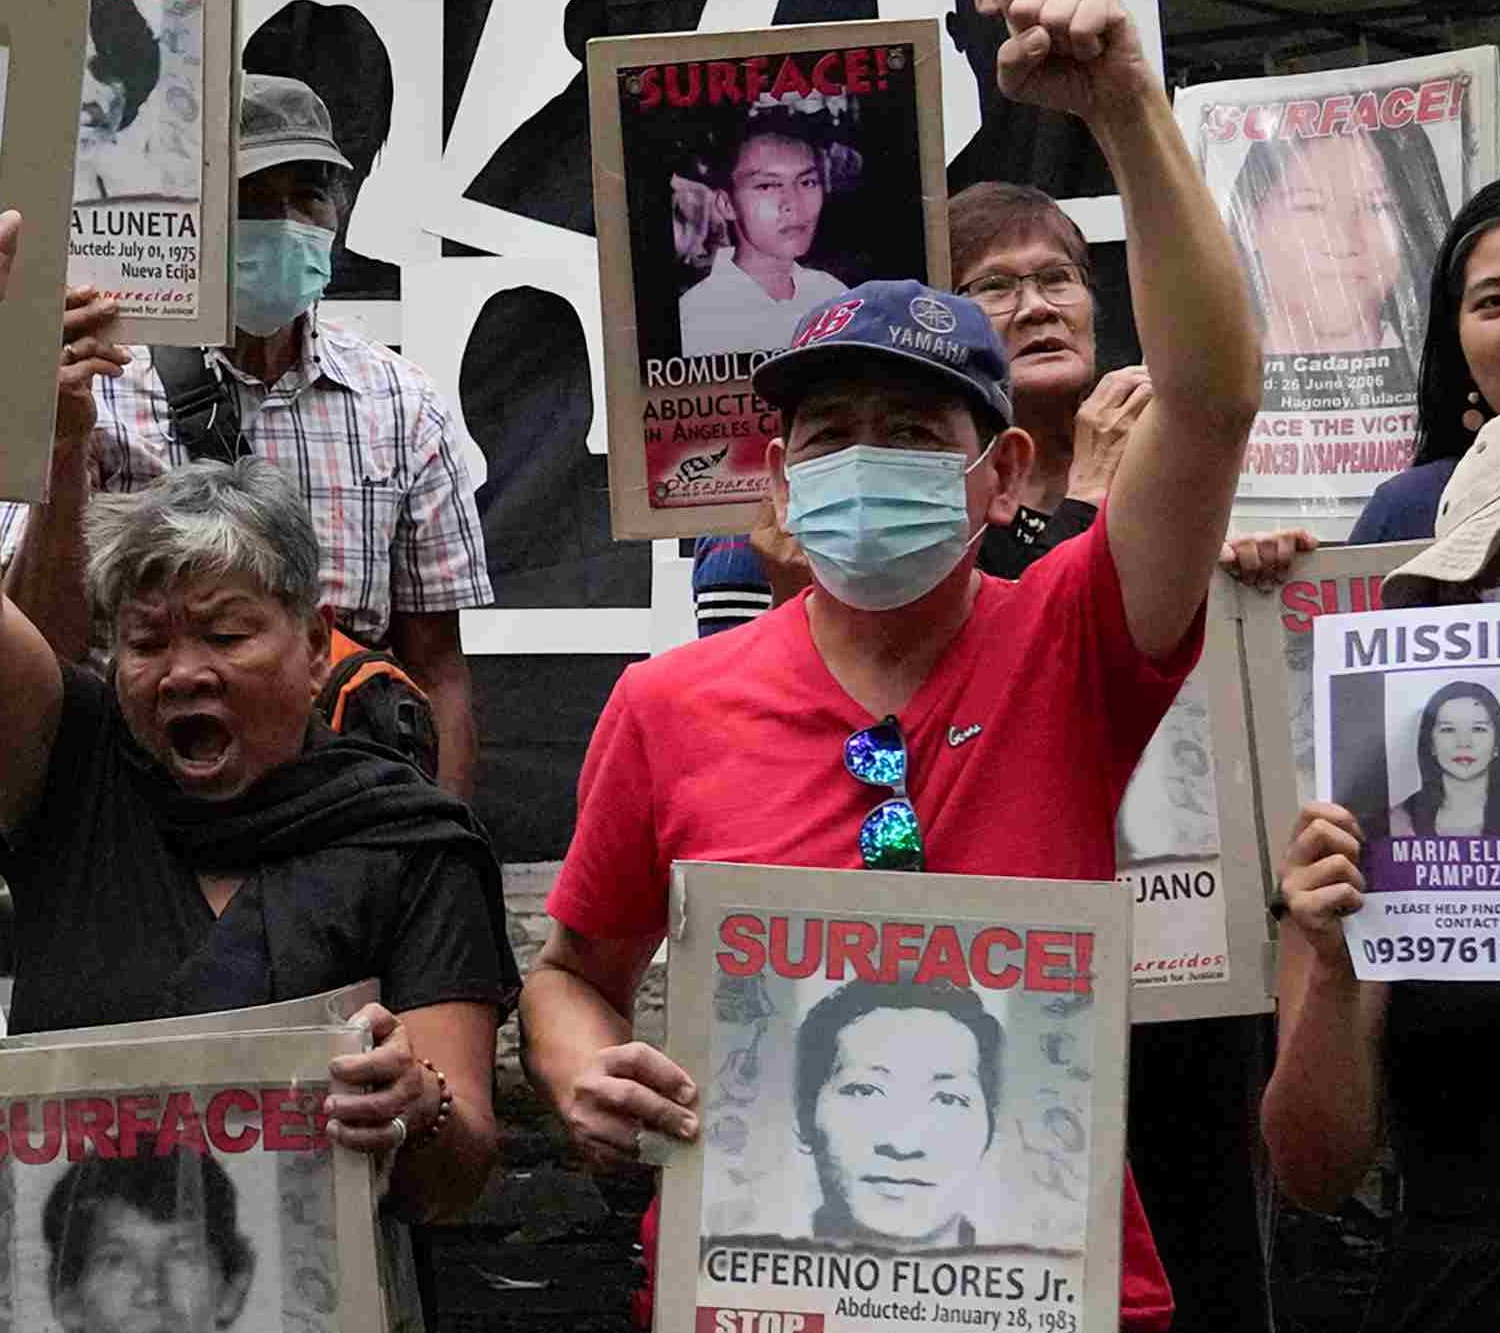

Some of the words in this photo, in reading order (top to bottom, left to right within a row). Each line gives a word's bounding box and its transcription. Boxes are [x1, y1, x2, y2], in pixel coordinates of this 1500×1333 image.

[641, 48, 889, 109] SURFACE!
[1206, 77, 1469, 141] SURFACE!
[93, 210, 197, 238] LUNETA
[118, 241, 144, 262] July
[148, 245, 165, 262] 01,
[169, 246, 196, 263] 1975
[121, 263, 163, 279] Nueva
[166, 264, 197, 283] Ecija
[888, 325, 969, 365] YAMAHA
[1293, 354, 1390, 375] Cadapan
[1310, 418, 1355, 437] THE
[1392, 840, 1461, 862] MARIA
[1385, 903, 1431, 916] PLEASE
[1434, 904, 1468, 916] HELP
[1434, 917, 1500, 929] CONTACT
[715, 913, 1096, 994] SURFACE!
[706, 1247, 880, 1292] CEFERINO
[892, 1260, 1026, 1301] FLORES
[1034, 1269, 1076, 1305] Jr.
[834, 1298, 928, 1324] Abducted:
[930, 1303, 1001, 1331] January
[1006, 1309, 1033, 1331] 28,
